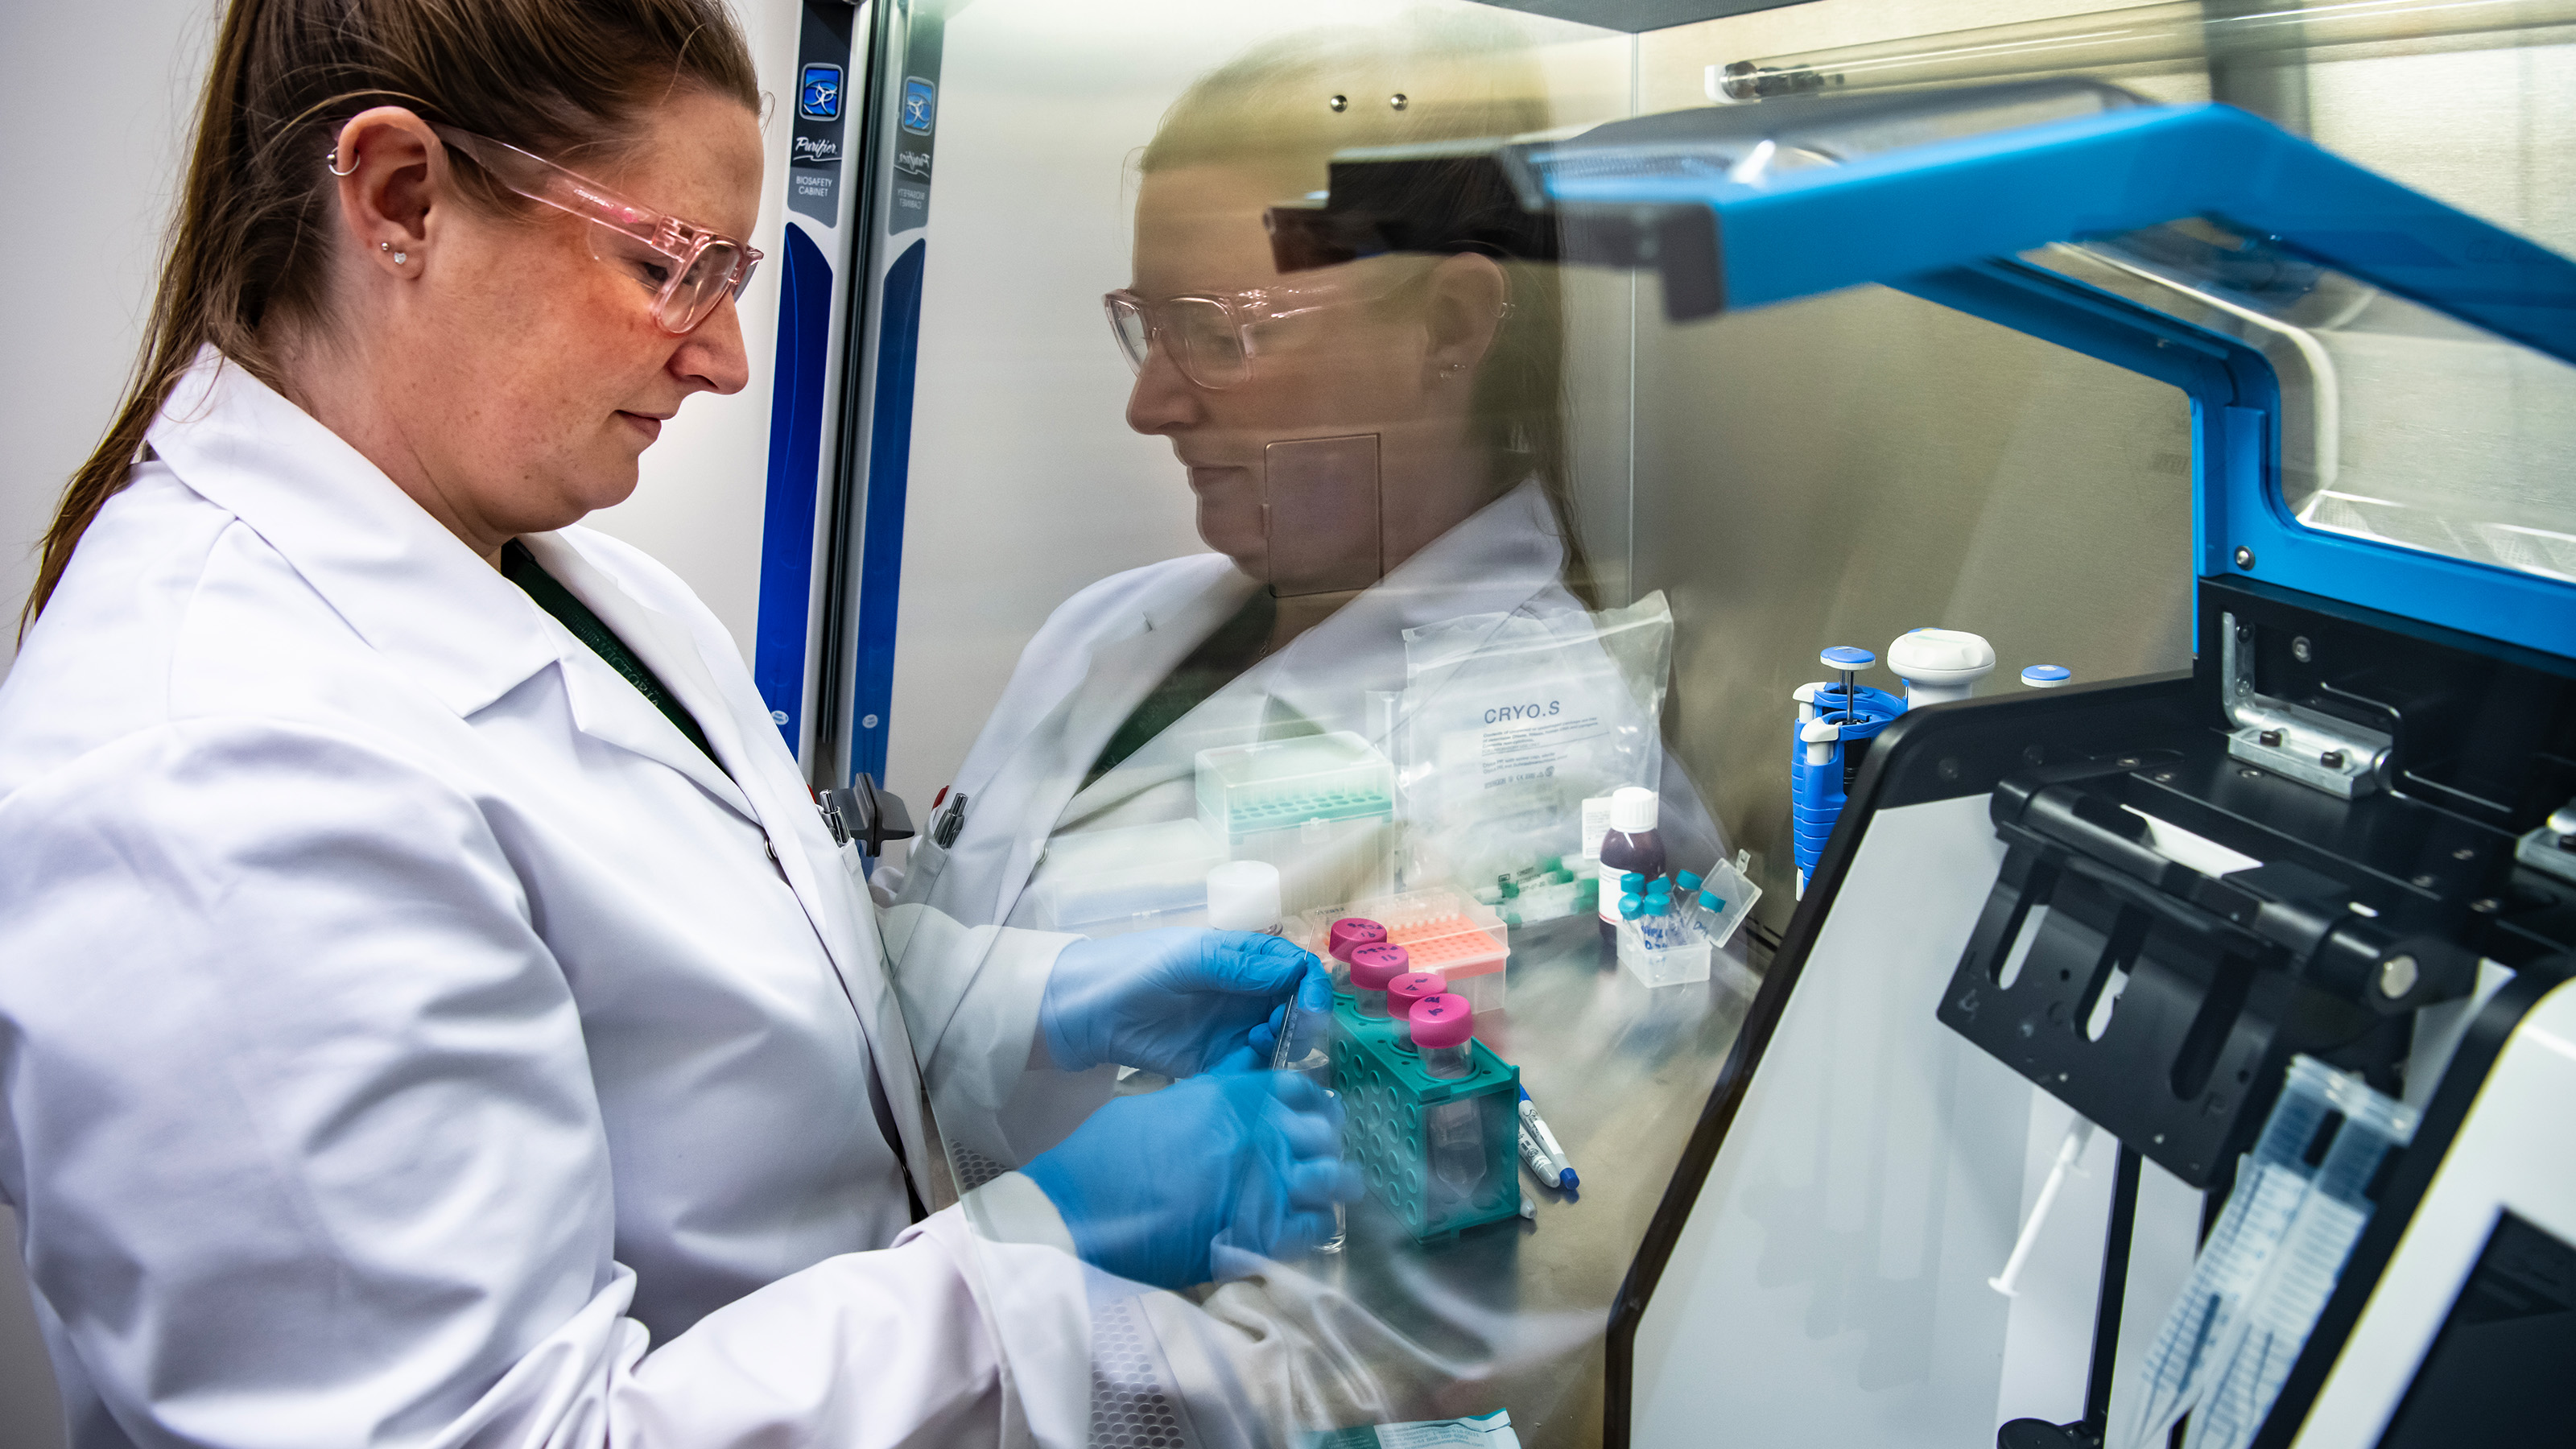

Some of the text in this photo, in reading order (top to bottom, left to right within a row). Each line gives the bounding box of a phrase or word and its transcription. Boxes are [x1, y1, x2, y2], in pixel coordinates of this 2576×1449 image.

[795, 175, 832, 187] BIOSAFETY
[799, 186, 828, 196] CABINET
[1484, 700, 1560, 724] CRYO.S
